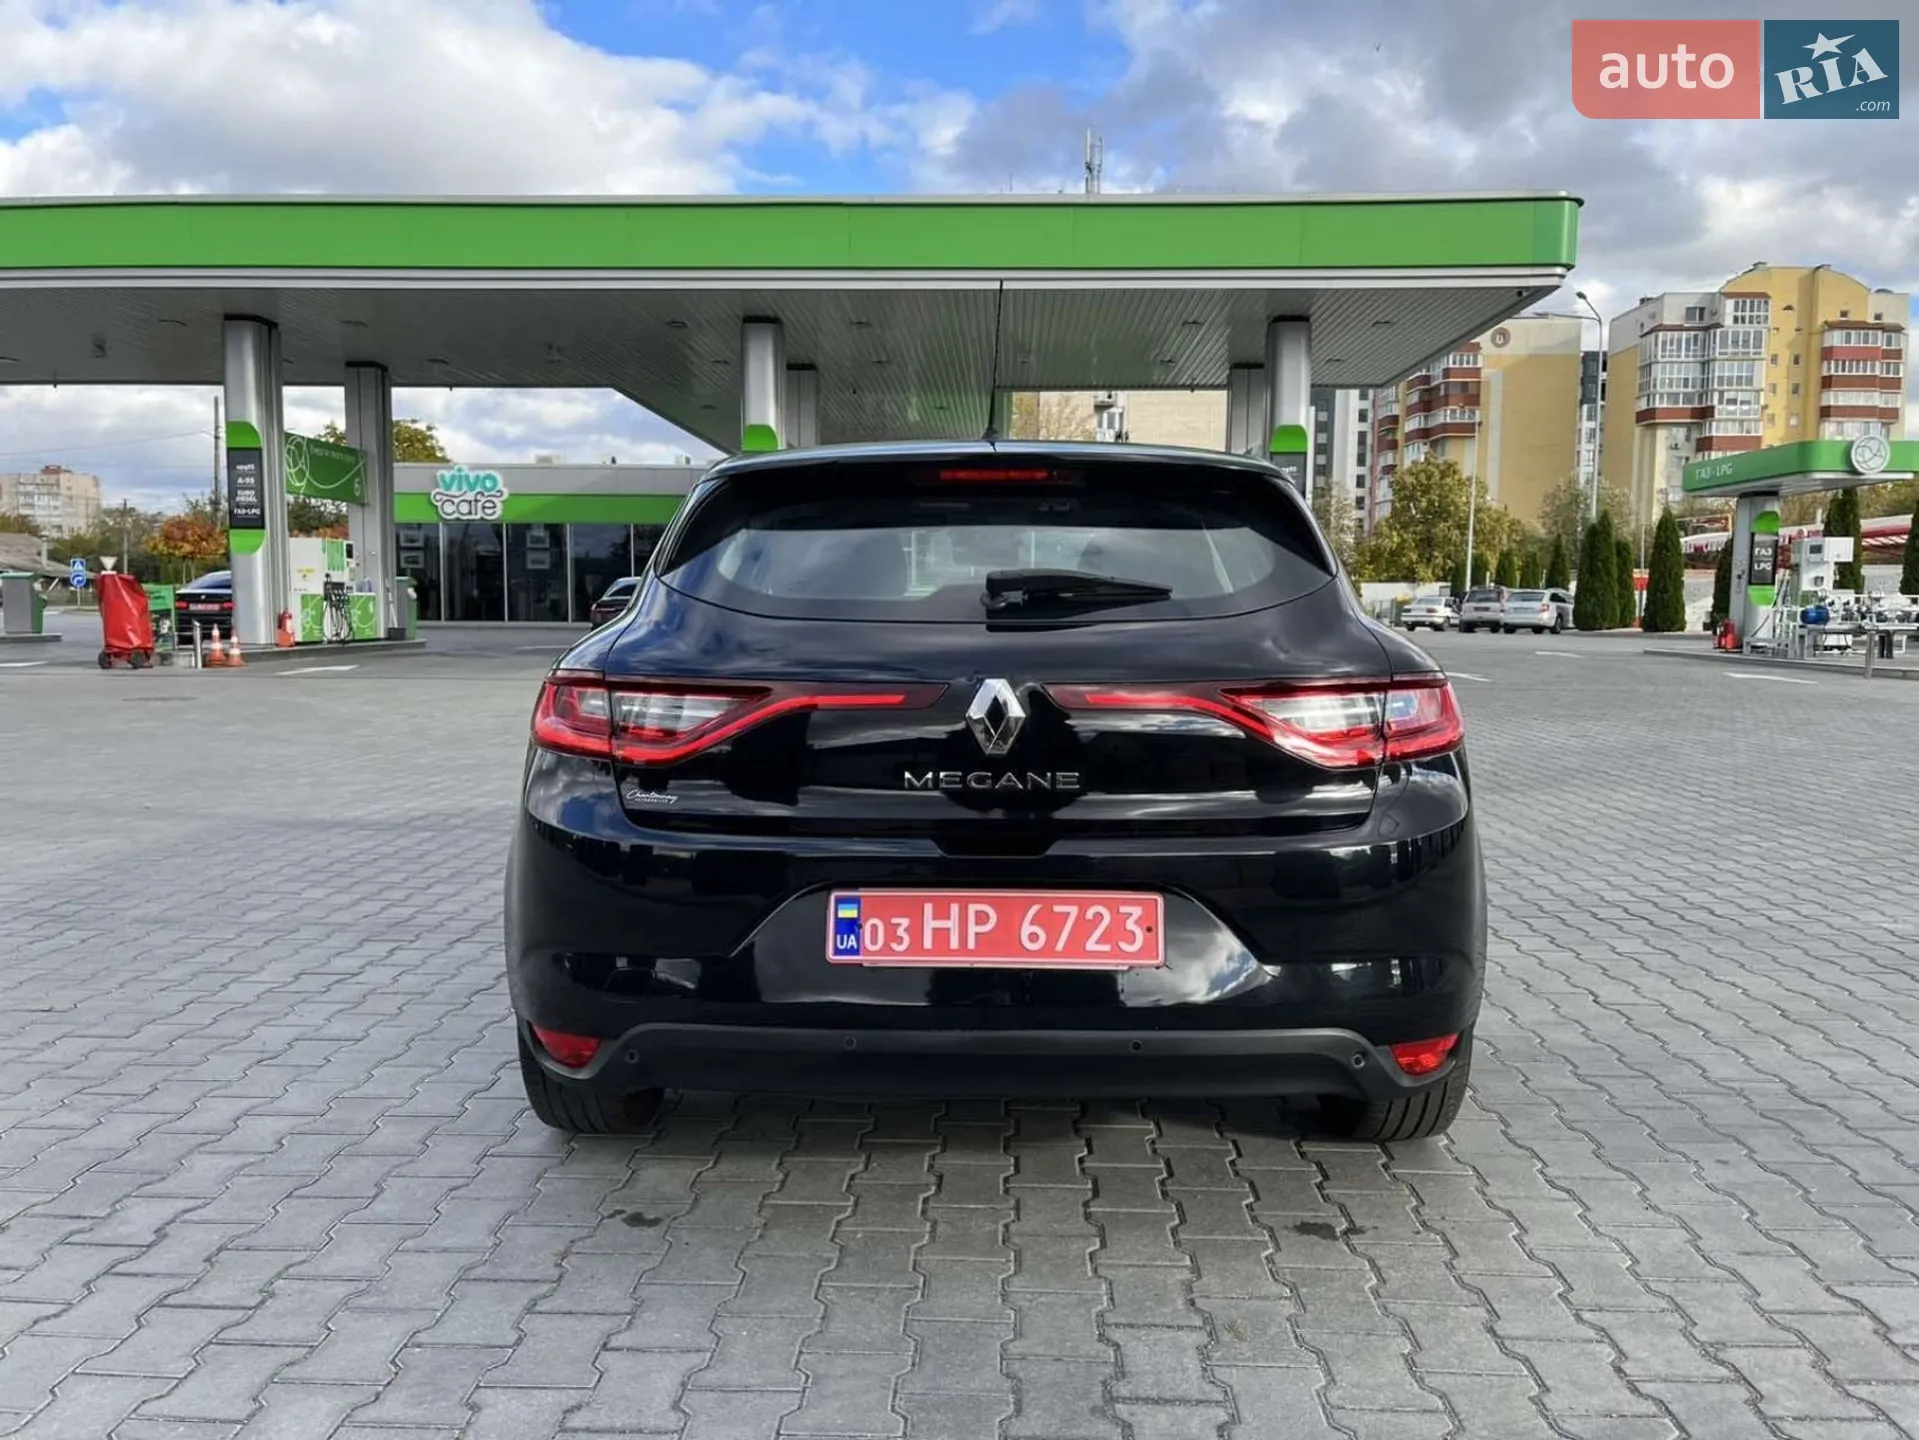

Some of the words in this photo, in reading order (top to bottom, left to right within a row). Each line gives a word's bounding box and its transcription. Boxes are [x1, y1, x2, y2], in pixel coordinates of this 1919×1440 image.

[439, 466, 499, 493] vivo
[440, 490, 498, 517] cafe
[1754, 546, 1773, 556] ГАЗ
[1754, 562, 1773, 571] LPG
[903, 770, 1081, 790] MEGANE
[836, 934, 858, 950] UA
[863, 917, 911, 952] 03
[922, 902, 998, 950] HP
[1020, 904, 1145, 954] 6723
